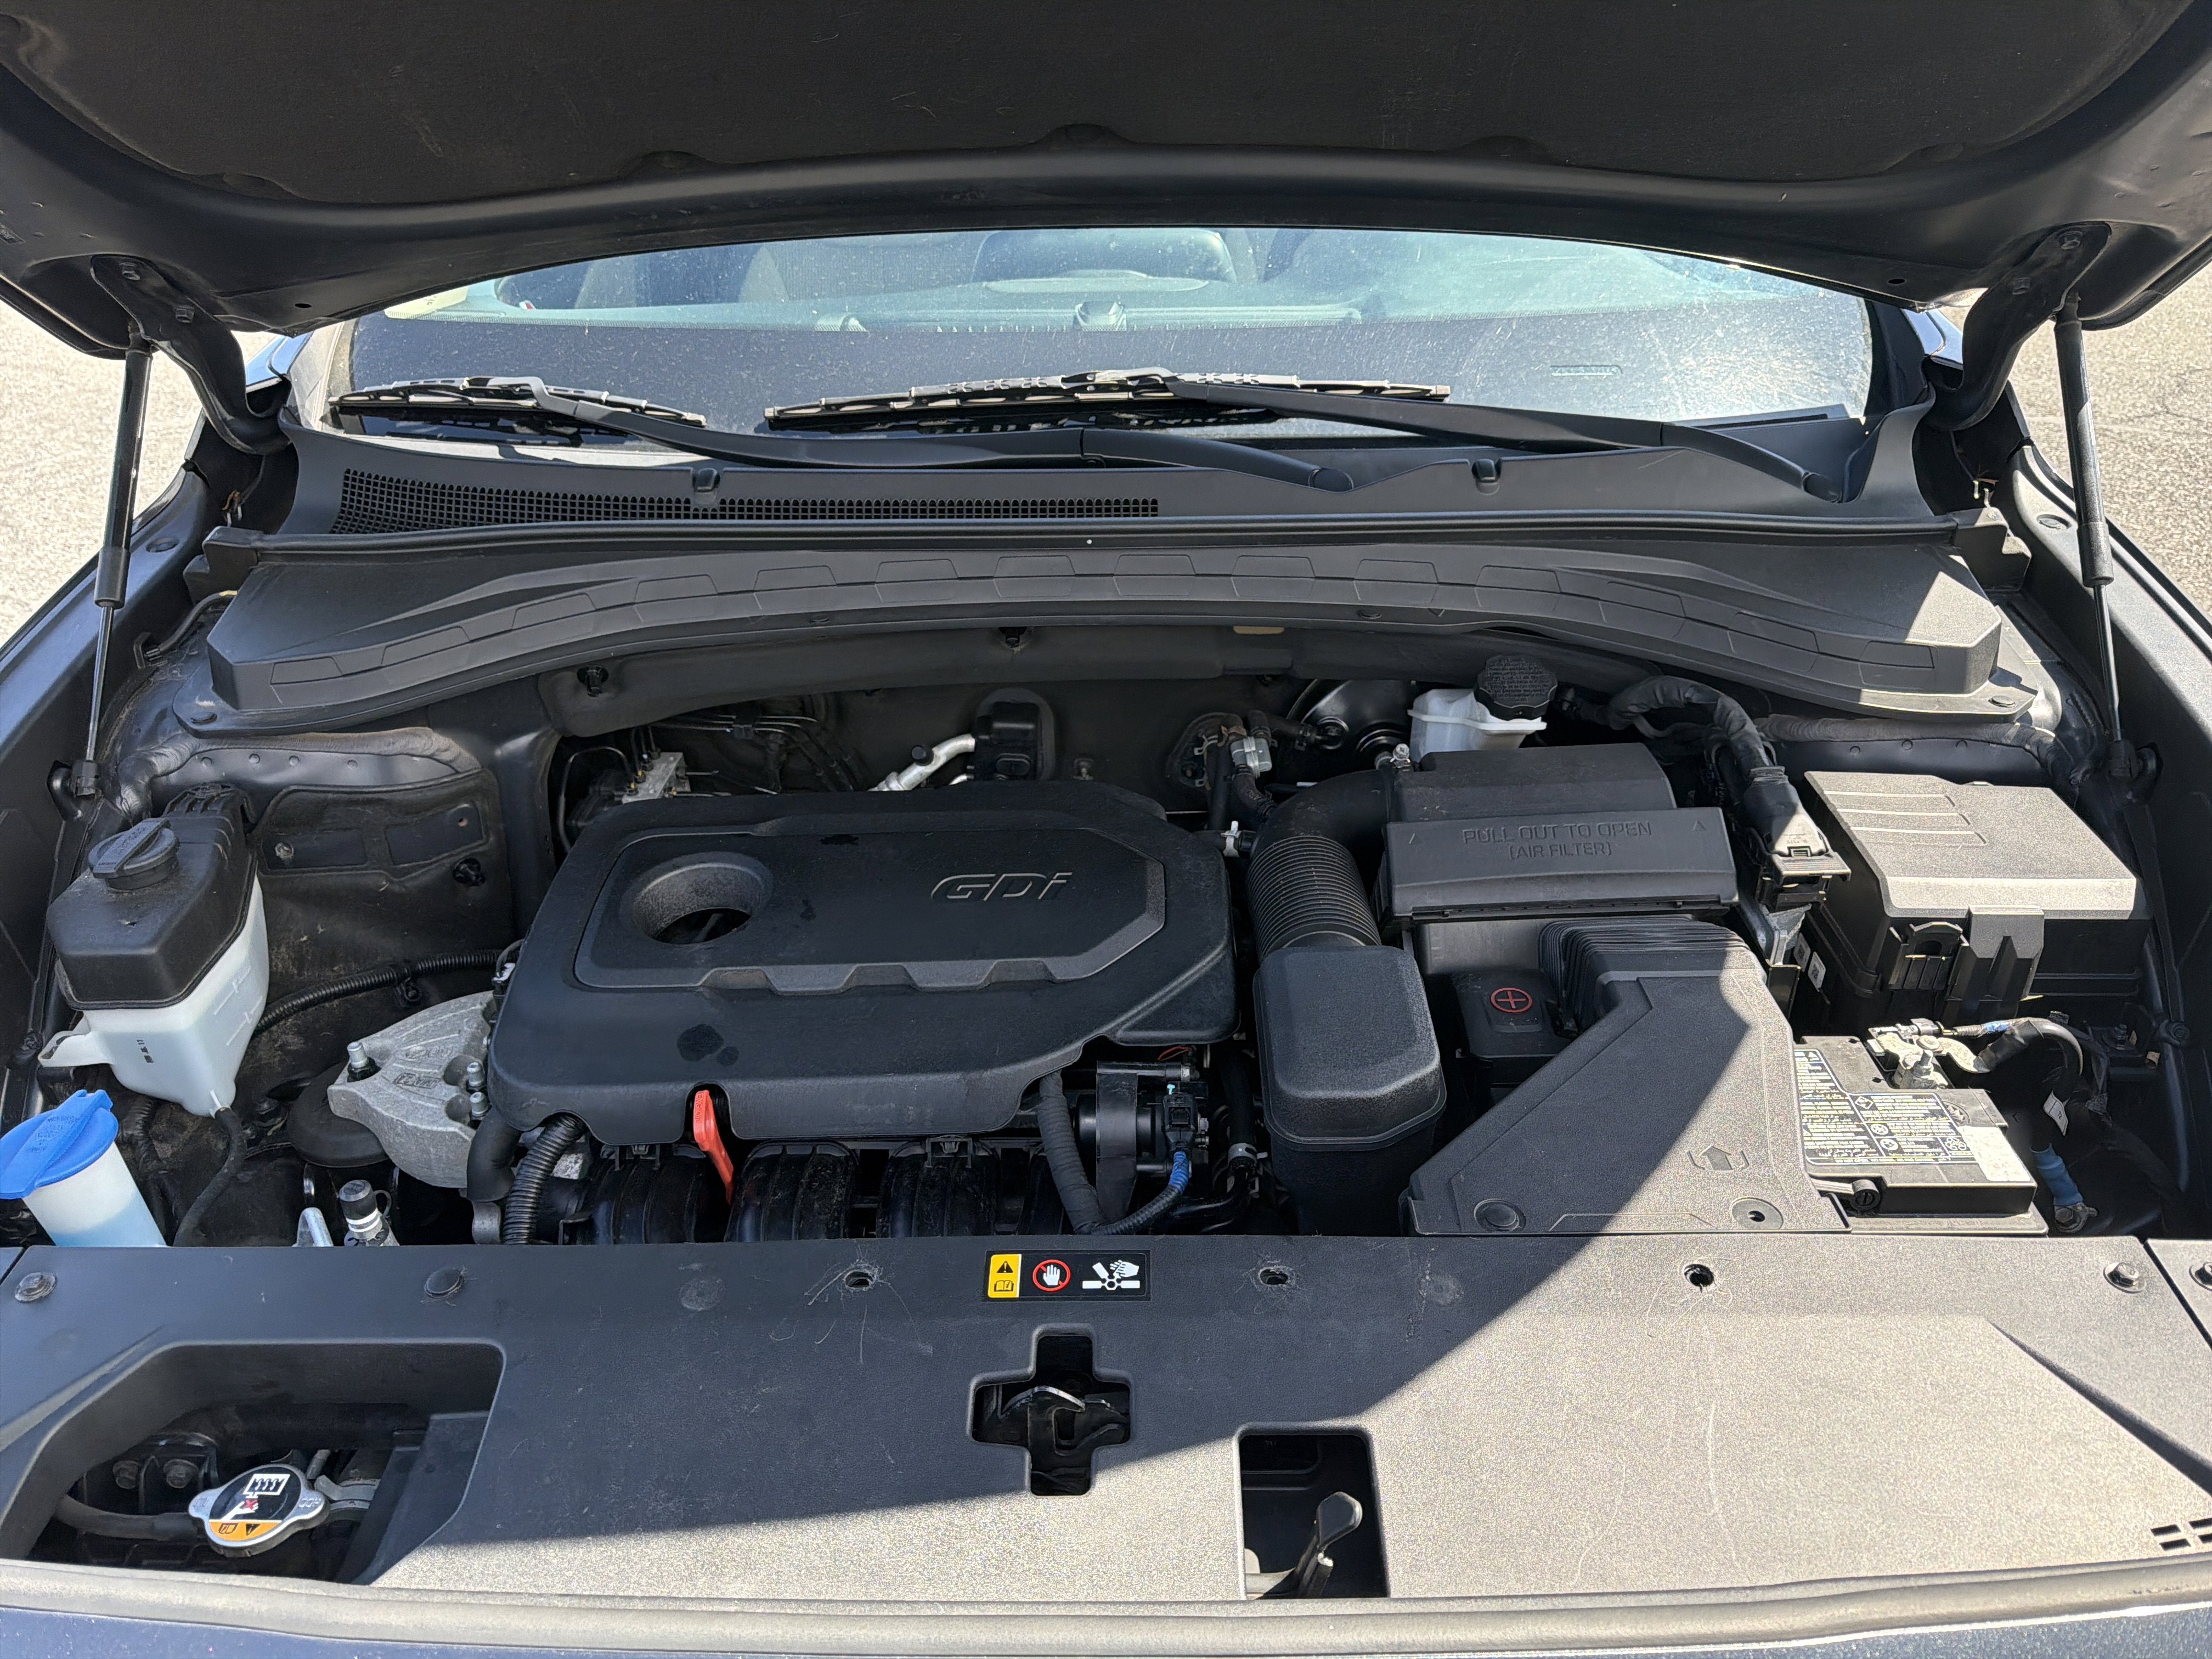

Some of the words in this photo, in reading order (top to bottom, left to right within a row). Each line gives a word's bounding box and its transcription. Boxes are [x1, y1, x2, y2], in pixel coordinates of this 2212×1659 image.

[1463, 827, 1515, 844] PULL
[1518, 825, 1559, 840] OUT
[1564, 823, 1591, 838] TO
[1597, 821, 1652, 837] OPEN
